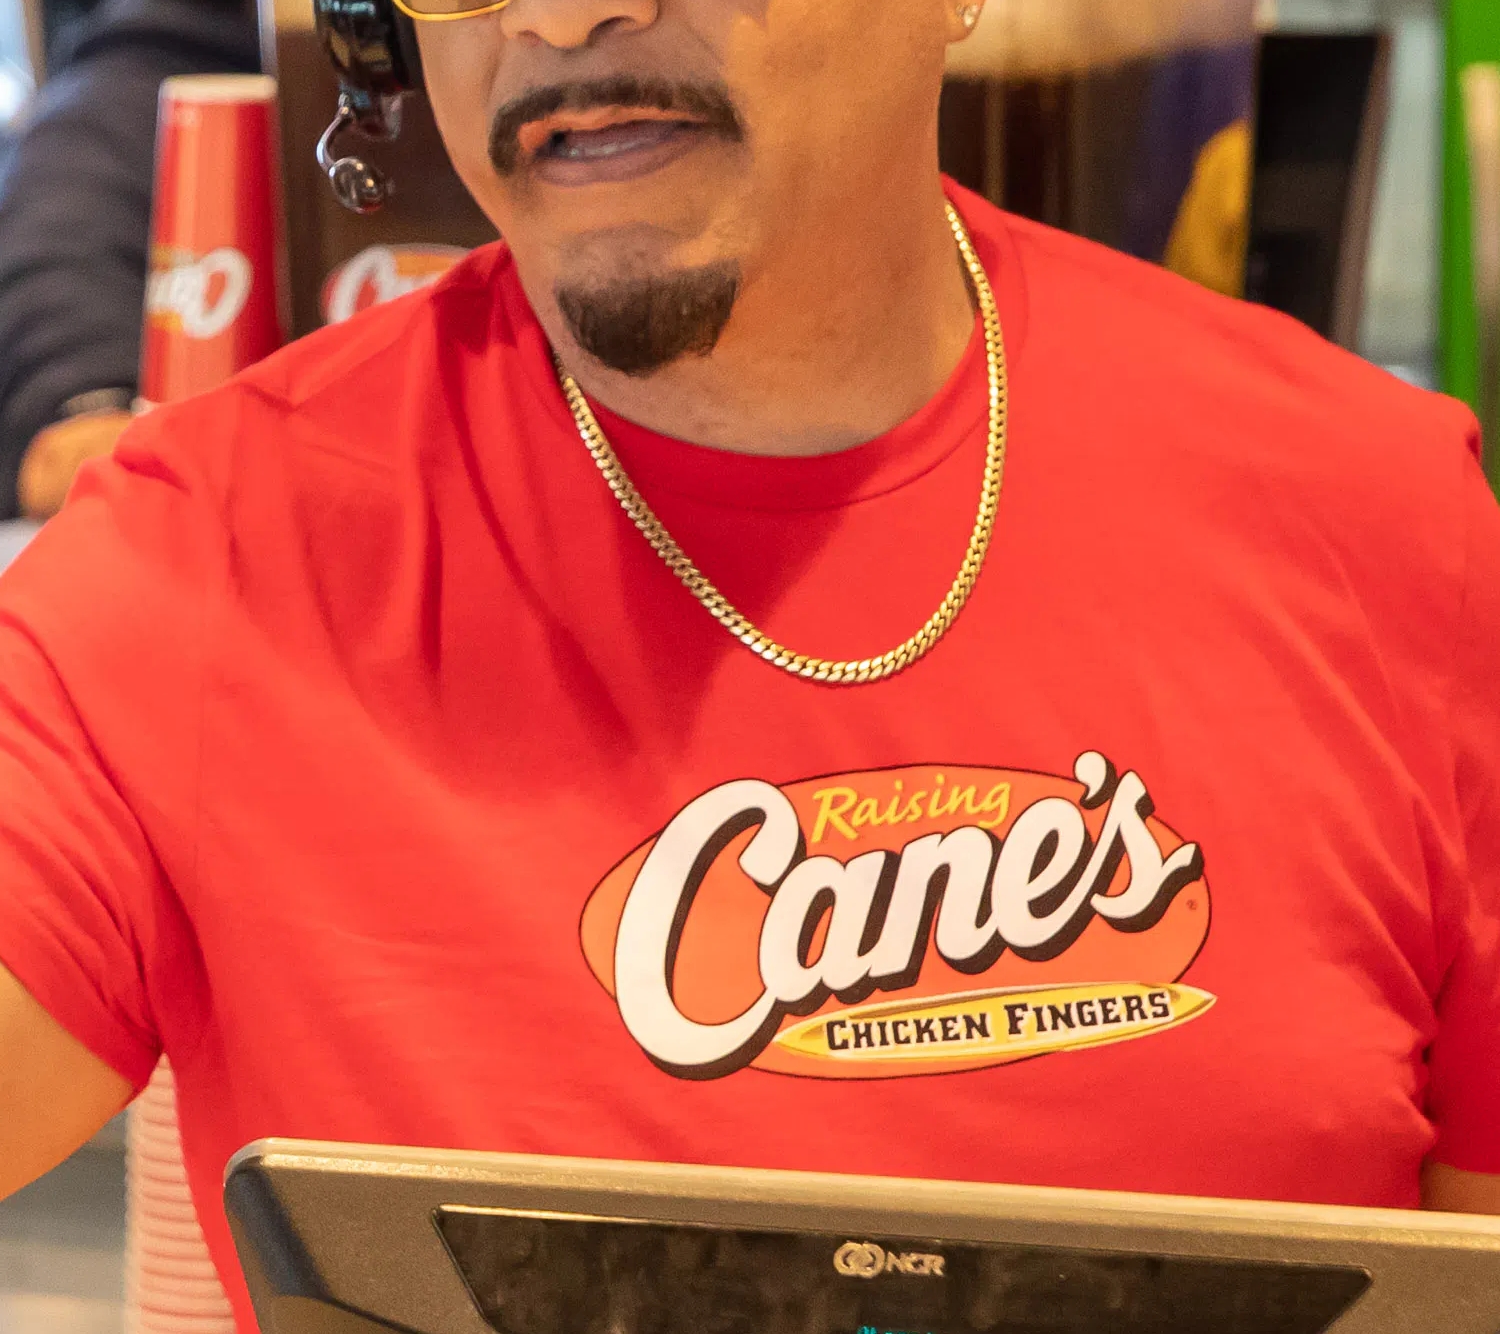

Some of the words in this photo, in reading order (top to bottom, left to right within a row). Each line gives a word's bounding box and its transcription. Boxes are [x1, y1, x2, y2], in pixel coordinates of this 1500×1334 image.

[810, 773, 1012, 845] Raising
[614, 750, 1204, 1078] Cane's
[825, 1008, 991, 1052] CHICKEN
[1004, 990, 1171, 1037] FINGERS
[885, 1251, 945, 1277] NCR
